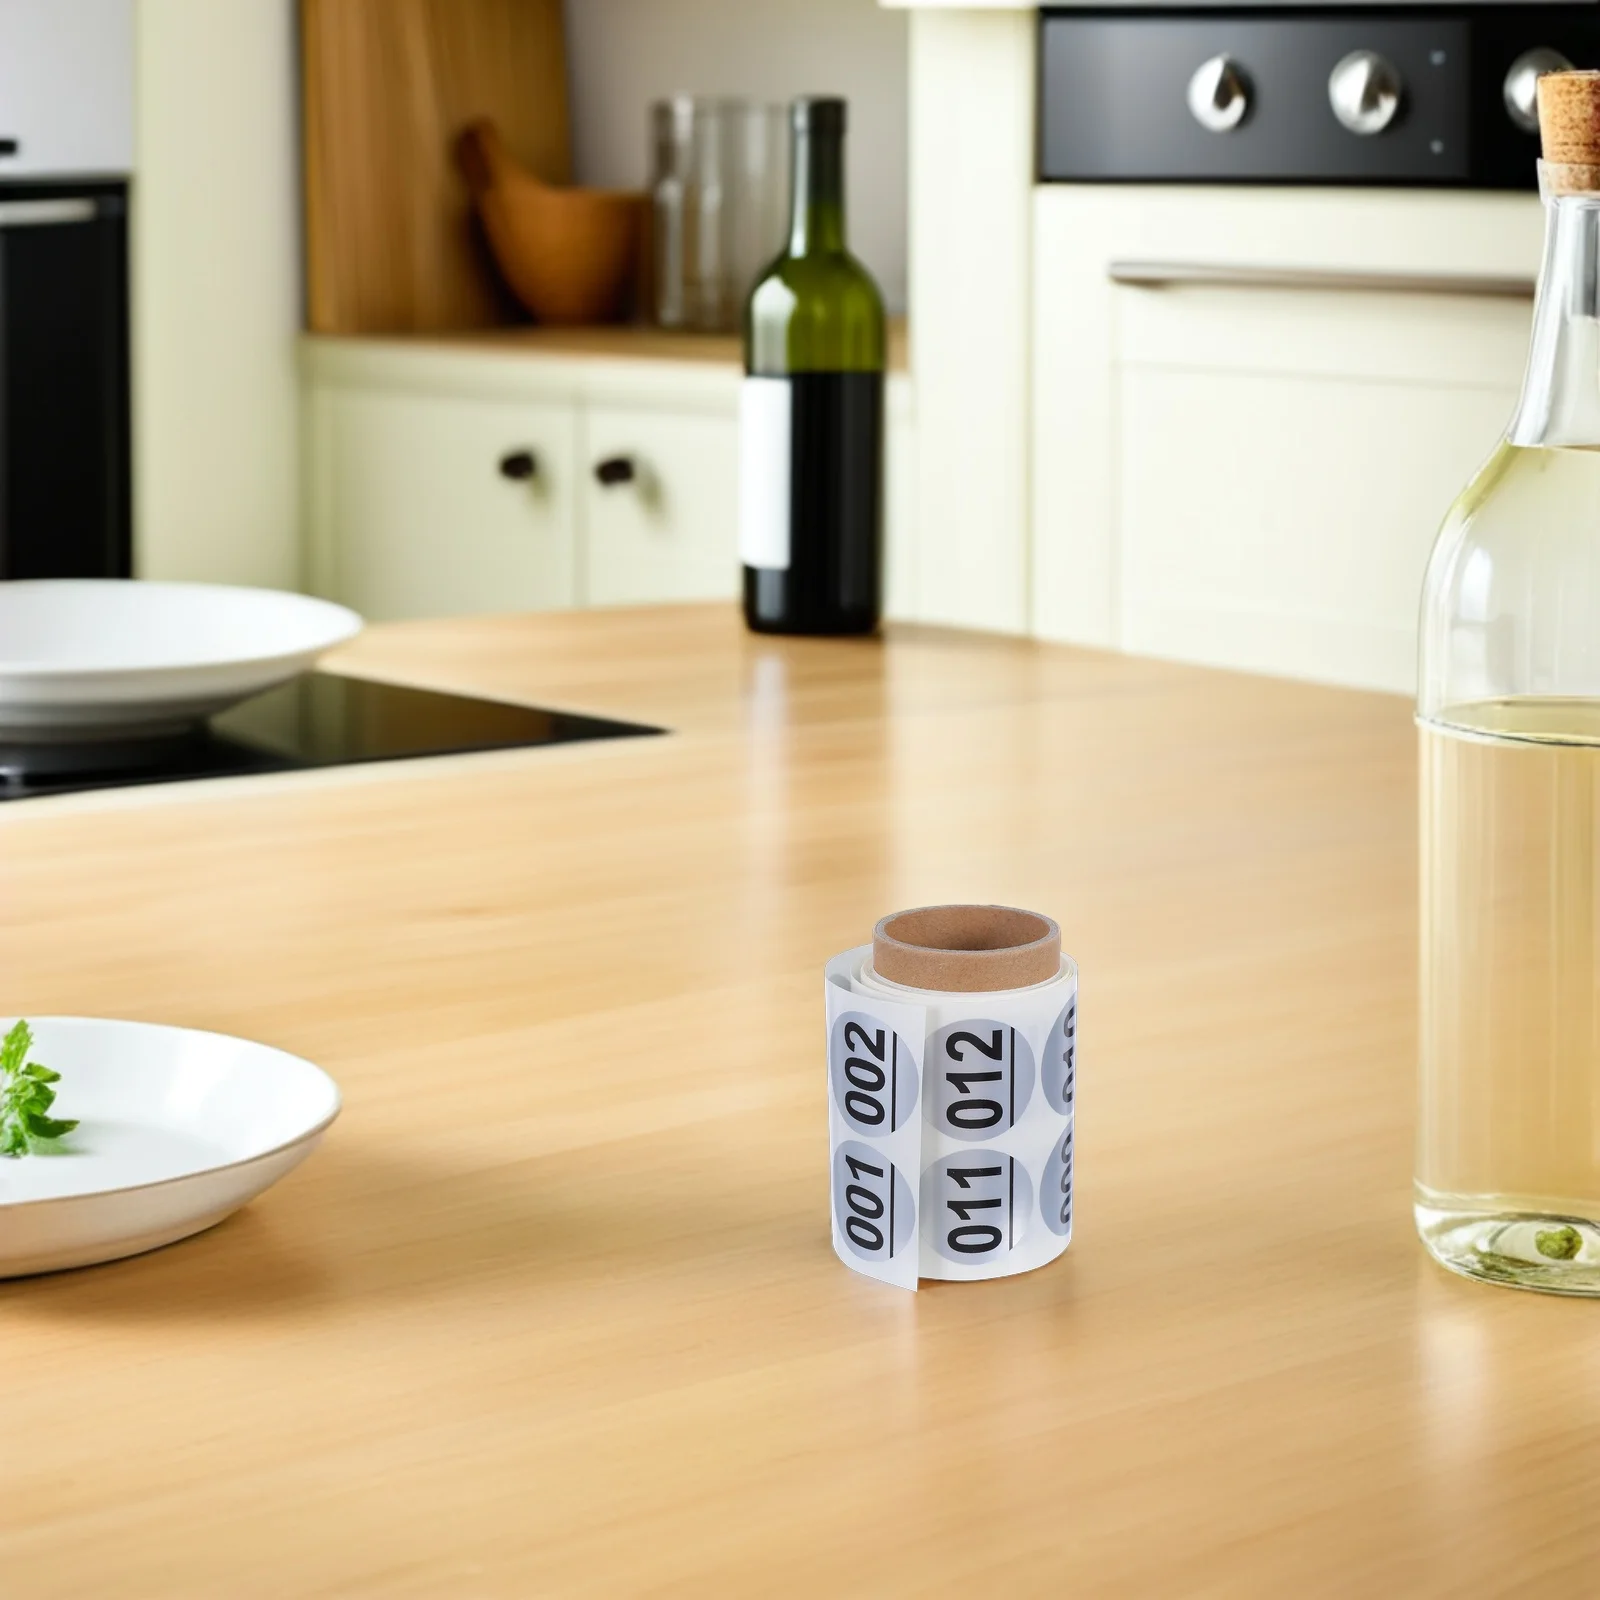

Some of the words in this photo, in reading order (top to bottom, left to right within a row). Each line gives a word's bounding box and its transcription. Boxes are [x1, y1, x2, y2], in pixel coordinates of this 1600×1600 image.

[844, 1021, 886, 1126] 002
[945, 1029, 1004, 1130] 012
[845, 1154, 885, 1251] 001
[946, 1166, 1003, 1254] 011
